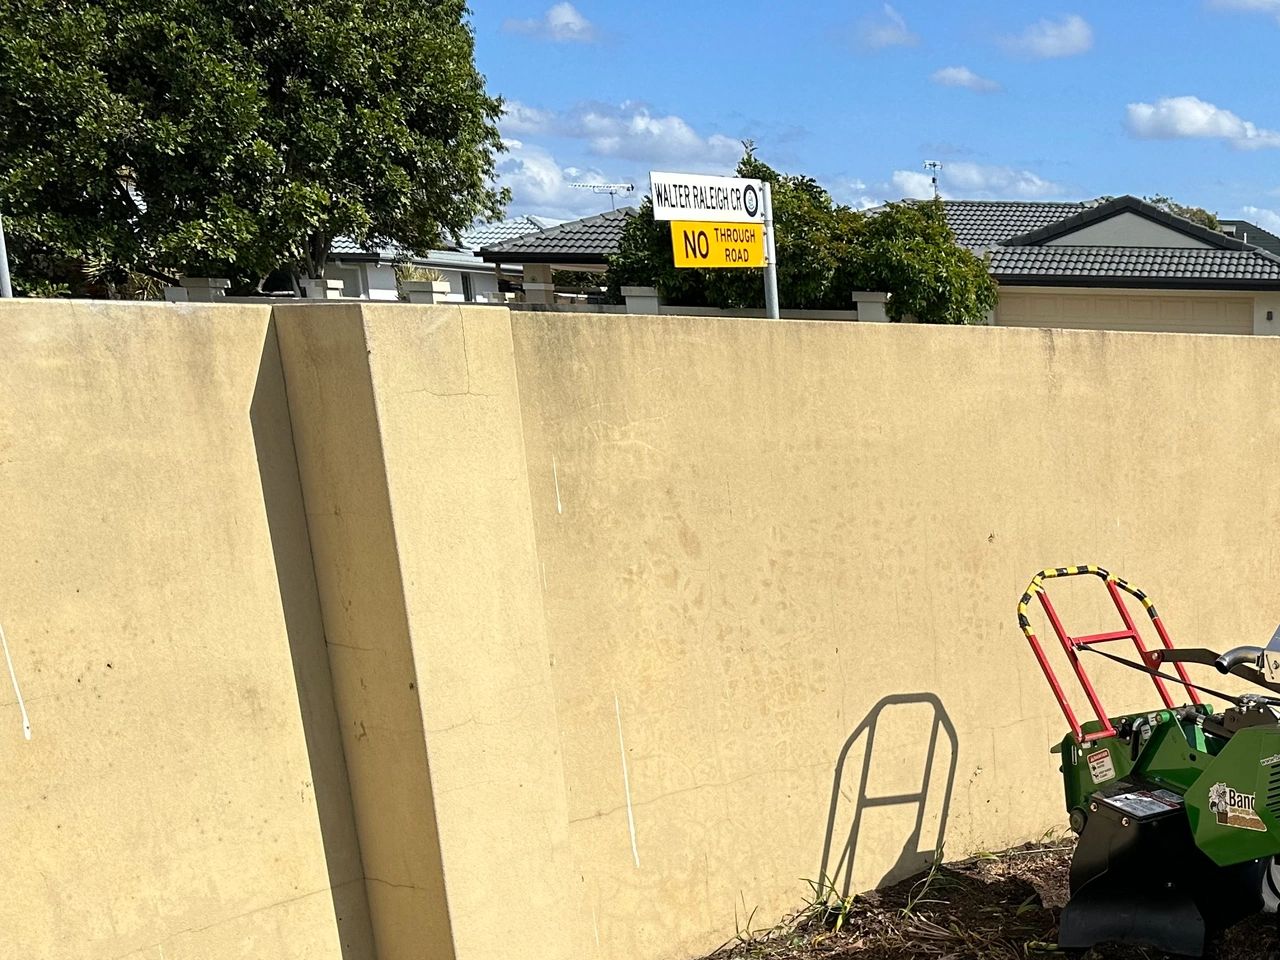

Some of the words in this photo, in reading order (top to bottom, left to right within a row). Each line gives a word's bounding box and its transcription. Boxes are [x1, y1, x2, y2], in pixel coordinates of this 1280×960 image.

[654, 182, 691, 208] WALTER
[693, 185, 730, 210] RALEIGH
[730, 188, 742, 211] CR
[683, 230, 709, 259] NO
[714, 227, 756, 243] THROUGH
[725, 248, 749, 262] ROAD
